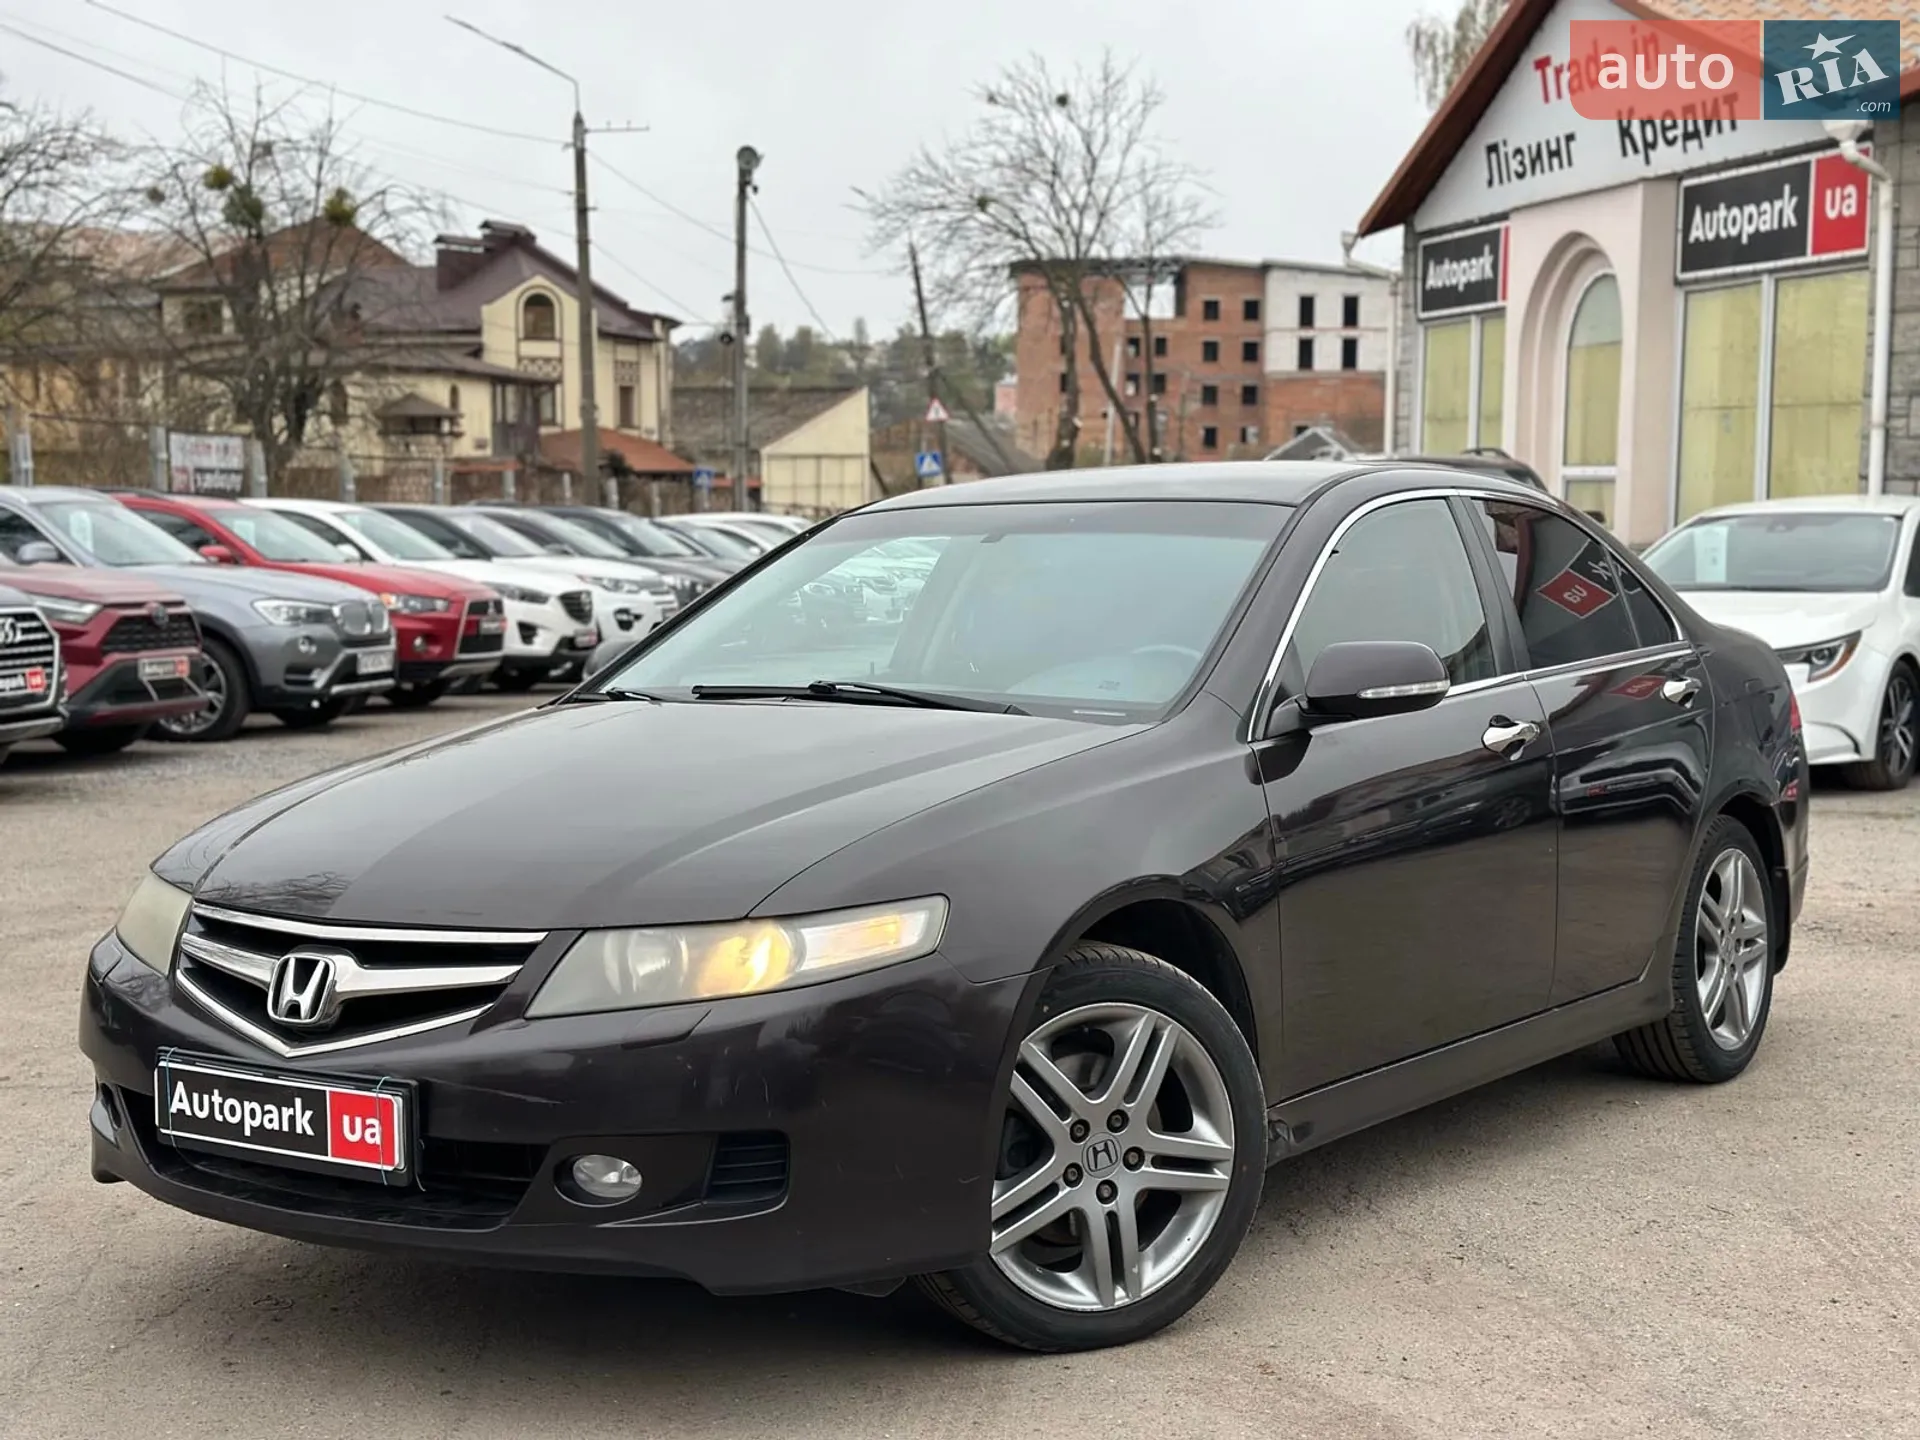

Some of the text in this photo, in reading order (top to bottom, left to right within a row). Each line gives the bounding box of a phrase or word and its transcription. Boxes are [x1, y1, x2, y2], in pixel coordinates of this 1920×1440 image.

[1485, 92, 1740, 188] Лізинг Кредит
[1688, 182, 1858, 245] Autopark ua
[1425, 243, 1494, 292] Autopark
[170, 1080, 382, 1146] Autopark ua
